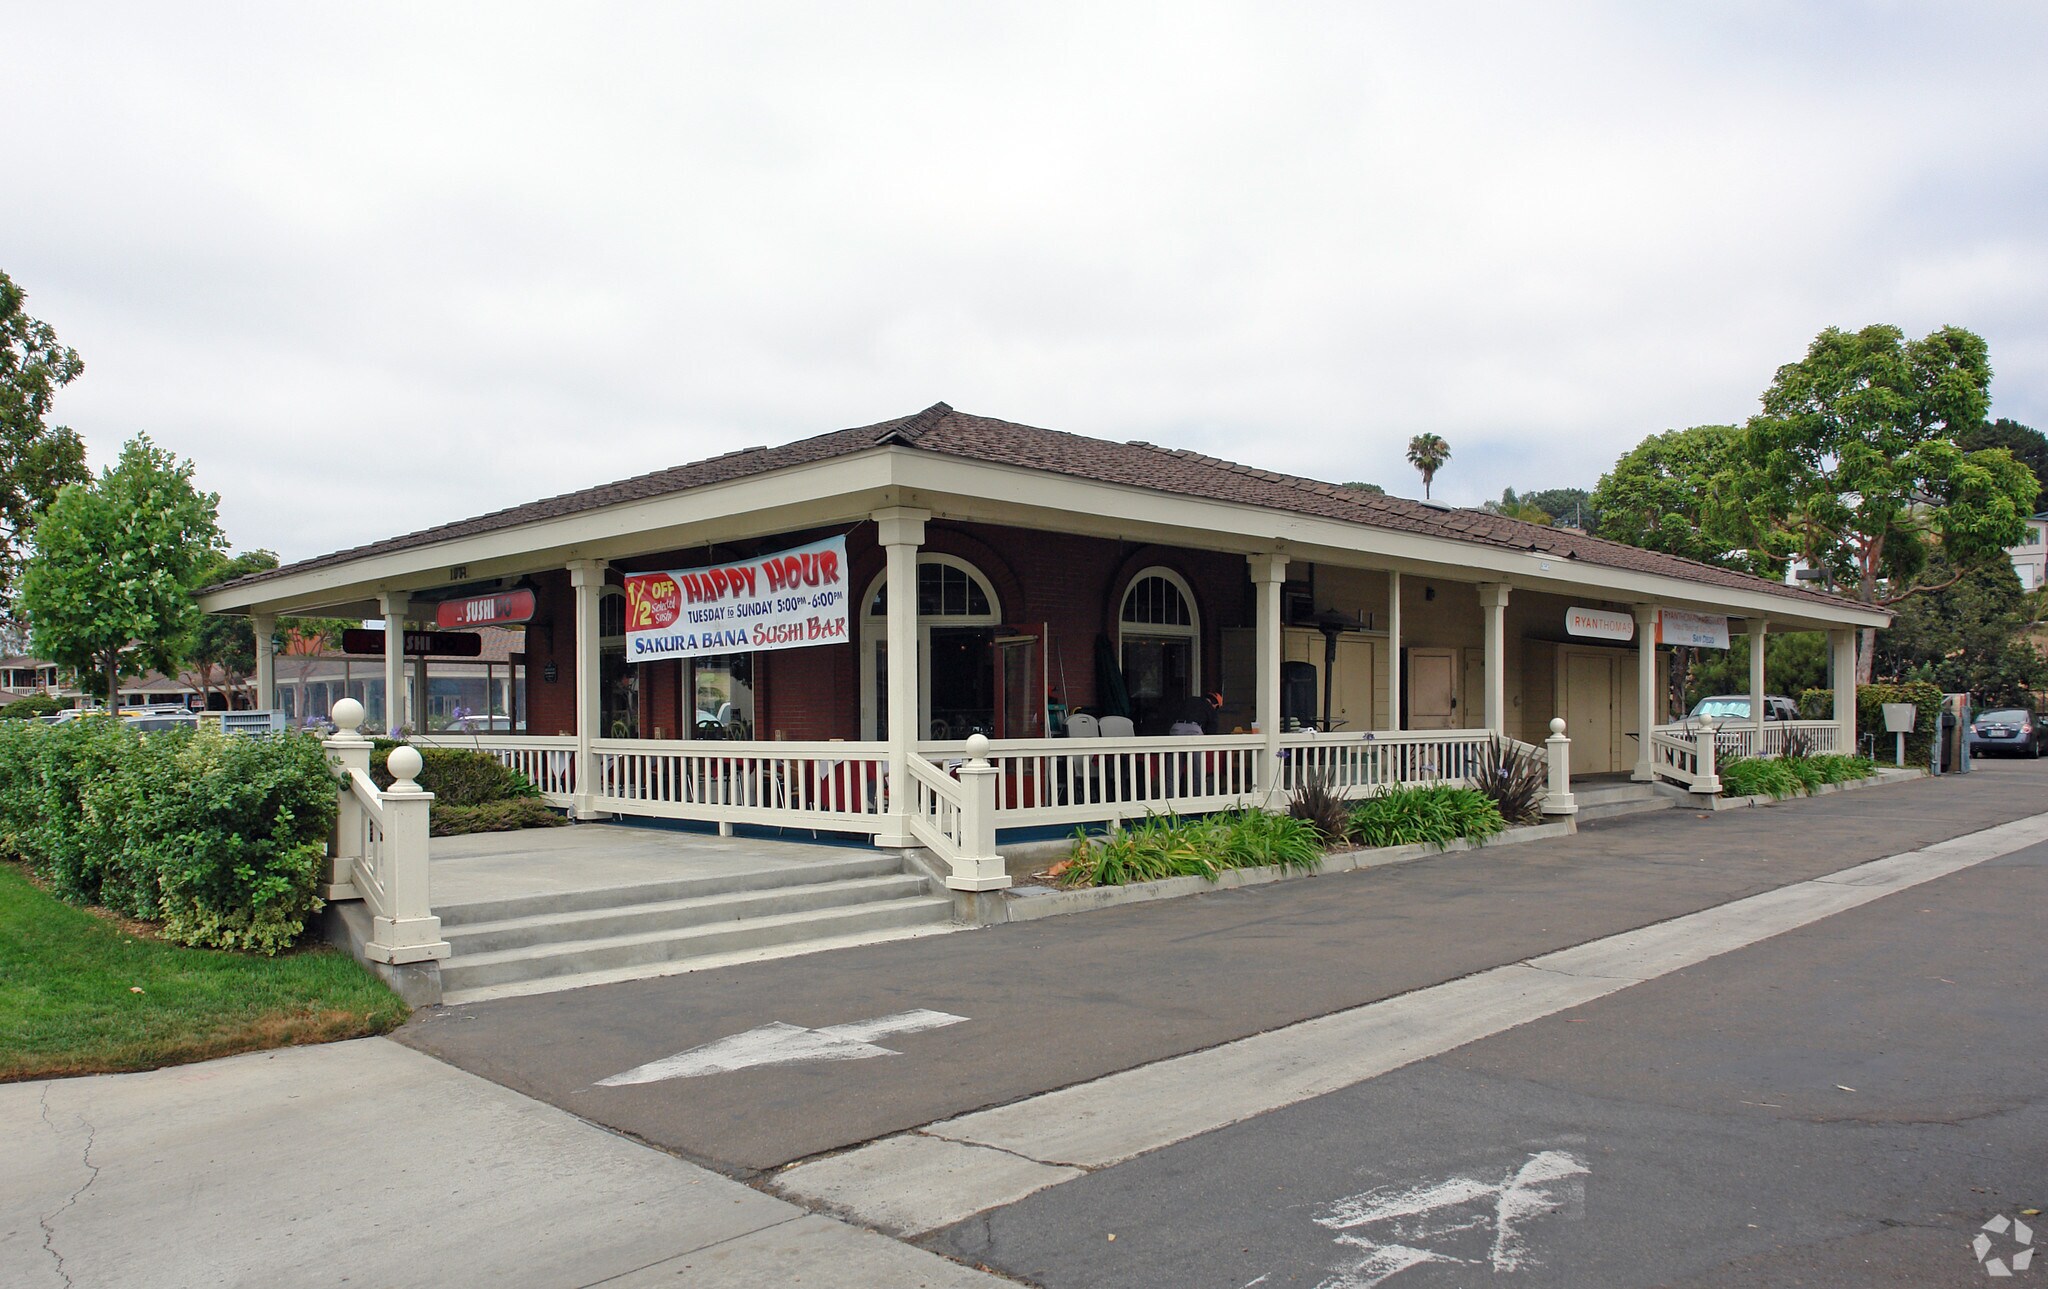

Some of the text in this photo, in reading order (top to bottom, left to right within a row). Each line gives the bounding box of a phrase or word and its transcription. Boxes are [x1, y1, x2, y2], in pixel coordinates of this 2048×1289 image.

[681, 550, 841, 605] HAPPY HOUR
[651, 581, 675, 599] OFF
[466, 599, 495, 622] SUSHI
[688, 607, 725, 624] TUESDAY
[737, 600, 773, 618] SUNDAY
[635, 615, 846, 655] SAKURA BANA SUSHI BAR
